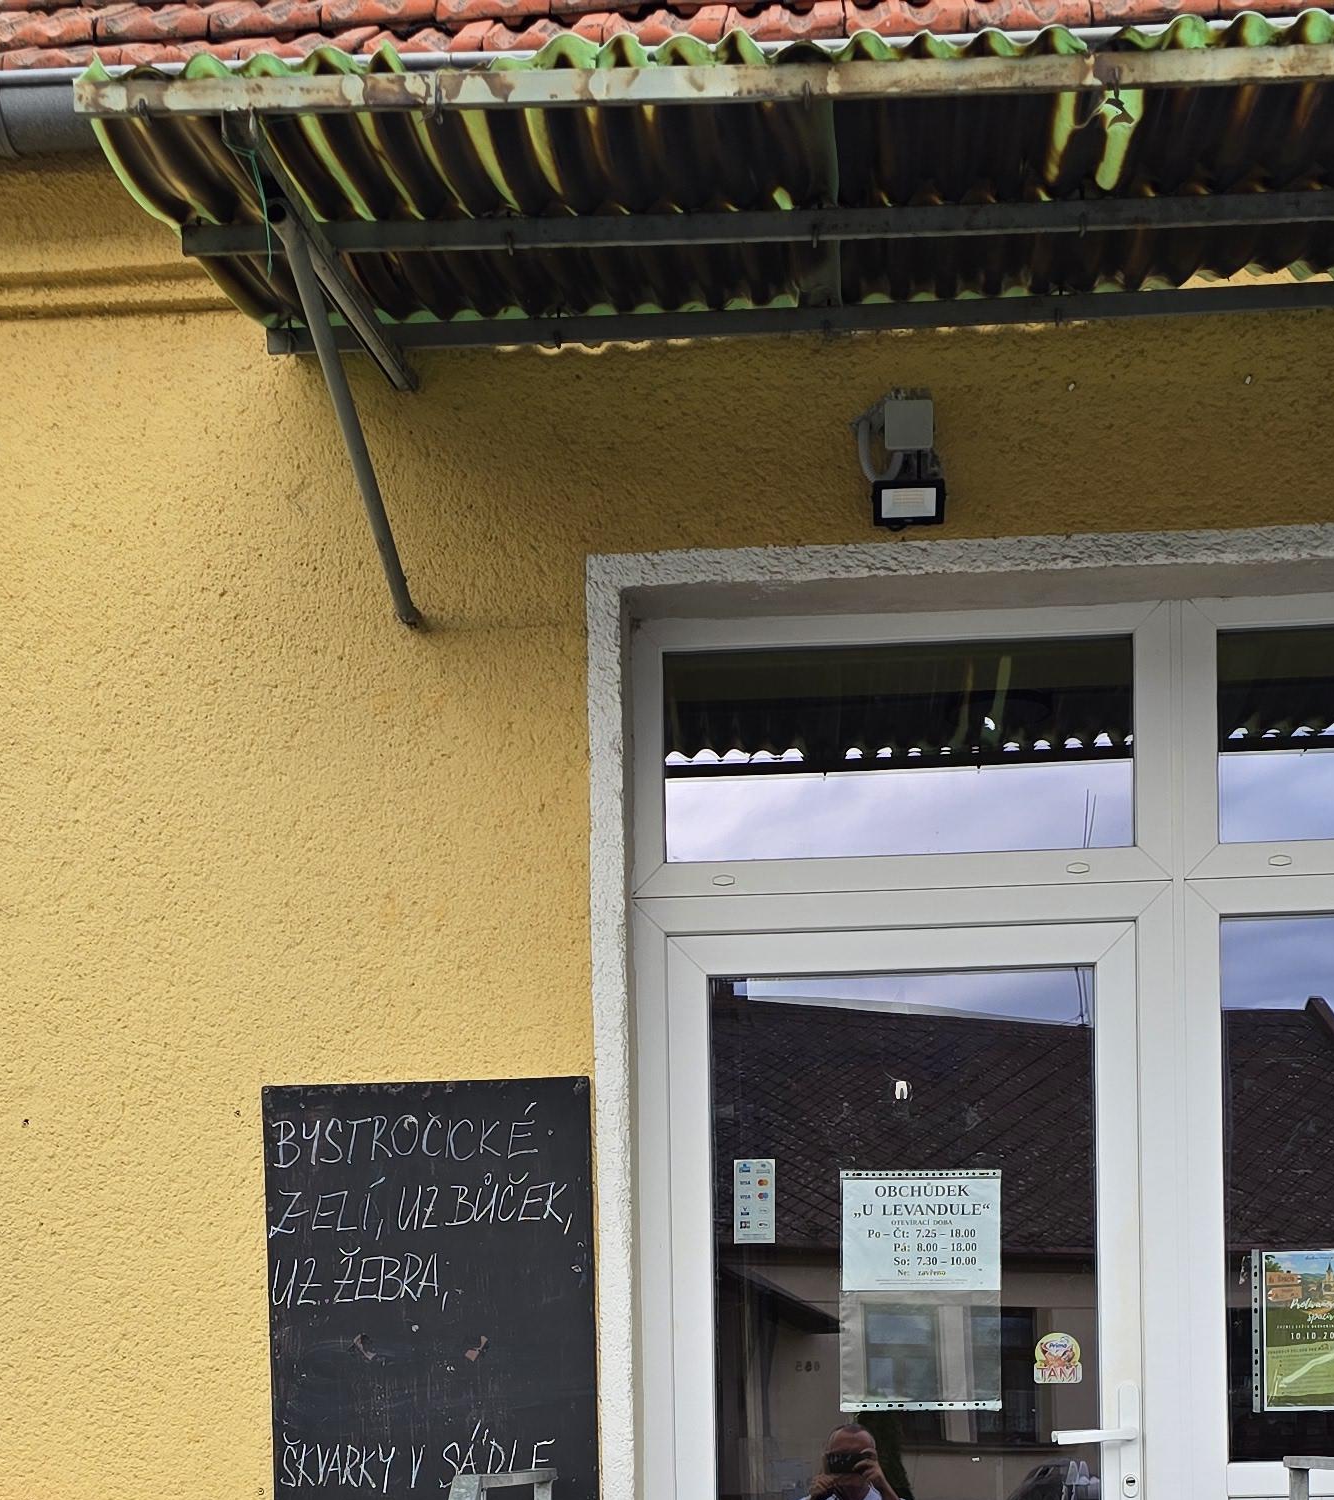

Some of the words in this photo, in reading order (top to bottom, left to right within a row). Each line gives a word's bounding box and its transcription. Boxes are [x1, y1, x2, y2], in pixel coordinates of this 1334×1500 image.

[874, 1182, 970, 1197] OBCHŮDEK
[867, 1229, 881, 1238] Po
[893, 1227, 910, 1238] Čt:
[916, 1229, 937, 1238] 7.25
[949, 1228, 976, 1238] 18.00
[893, 1242, 910, 1252] Pá:
[916, 1243, 938, 1252] 8.00
[951, 1243, 977, 1252] 18.00
[893, 1256, 910, 1266] So:
[917, 1257, 938, 1266] 7.30
[951, 1257, 977, 1266] 10.00
[280, 1432, 396, 1494] ŠKVARKY
[410, 1444, 426, 1488] V
